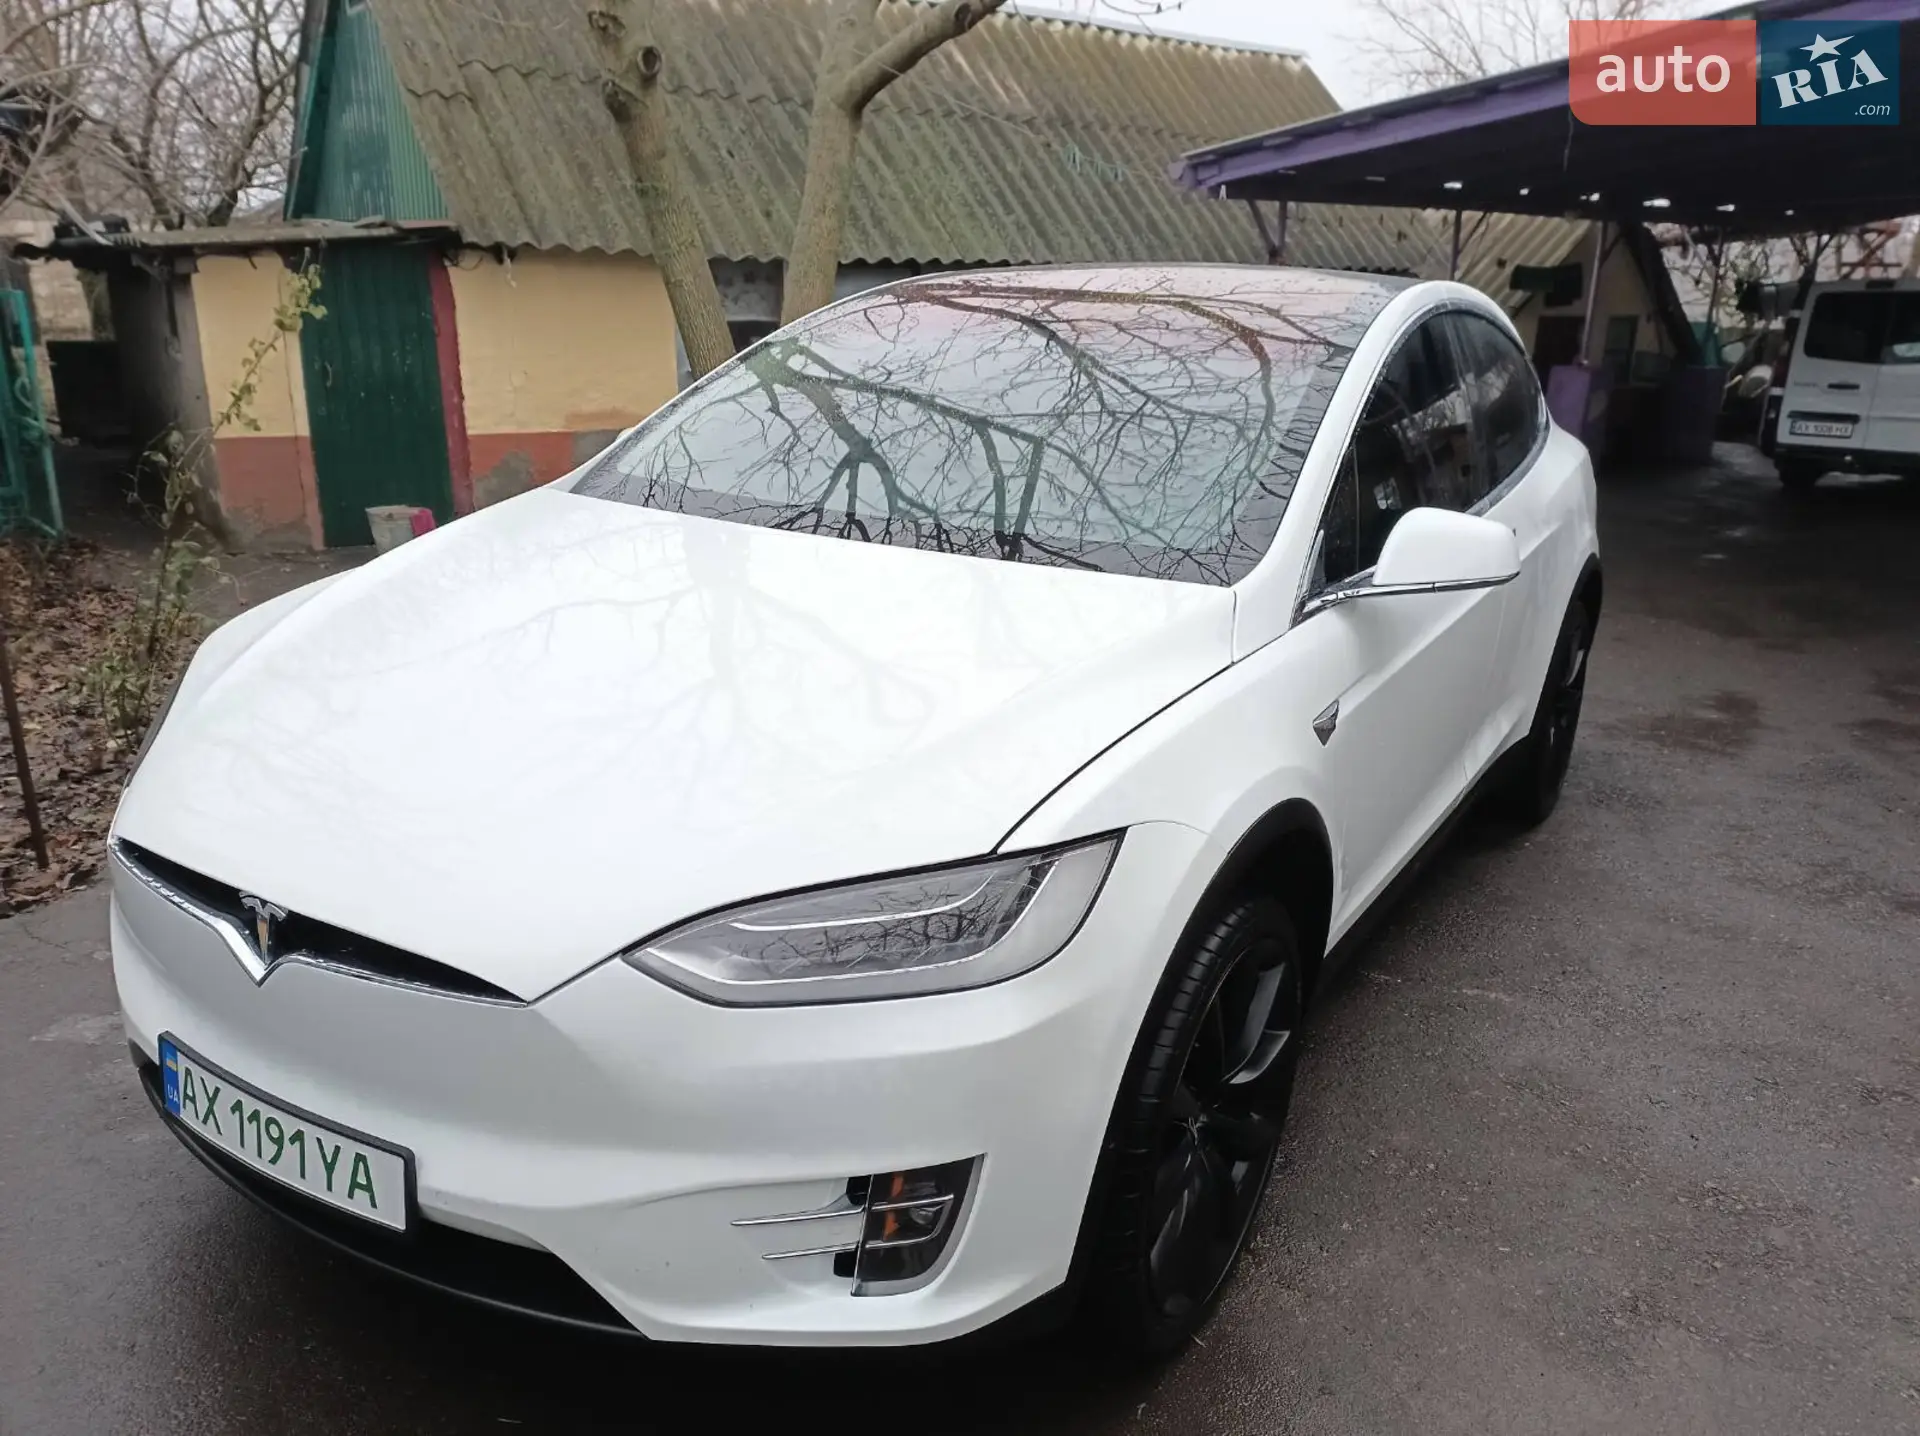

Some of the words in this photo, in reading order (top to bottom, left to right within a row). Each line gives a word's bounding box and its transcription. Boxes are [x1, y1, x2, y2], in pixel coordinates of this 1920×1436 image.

[167, 1083, 180, 1104] UA
[182, 1066, 223, 1136] AX
[230, 1099, 306, 1180] 1191
[316, 1136, 378, 1209] YA
